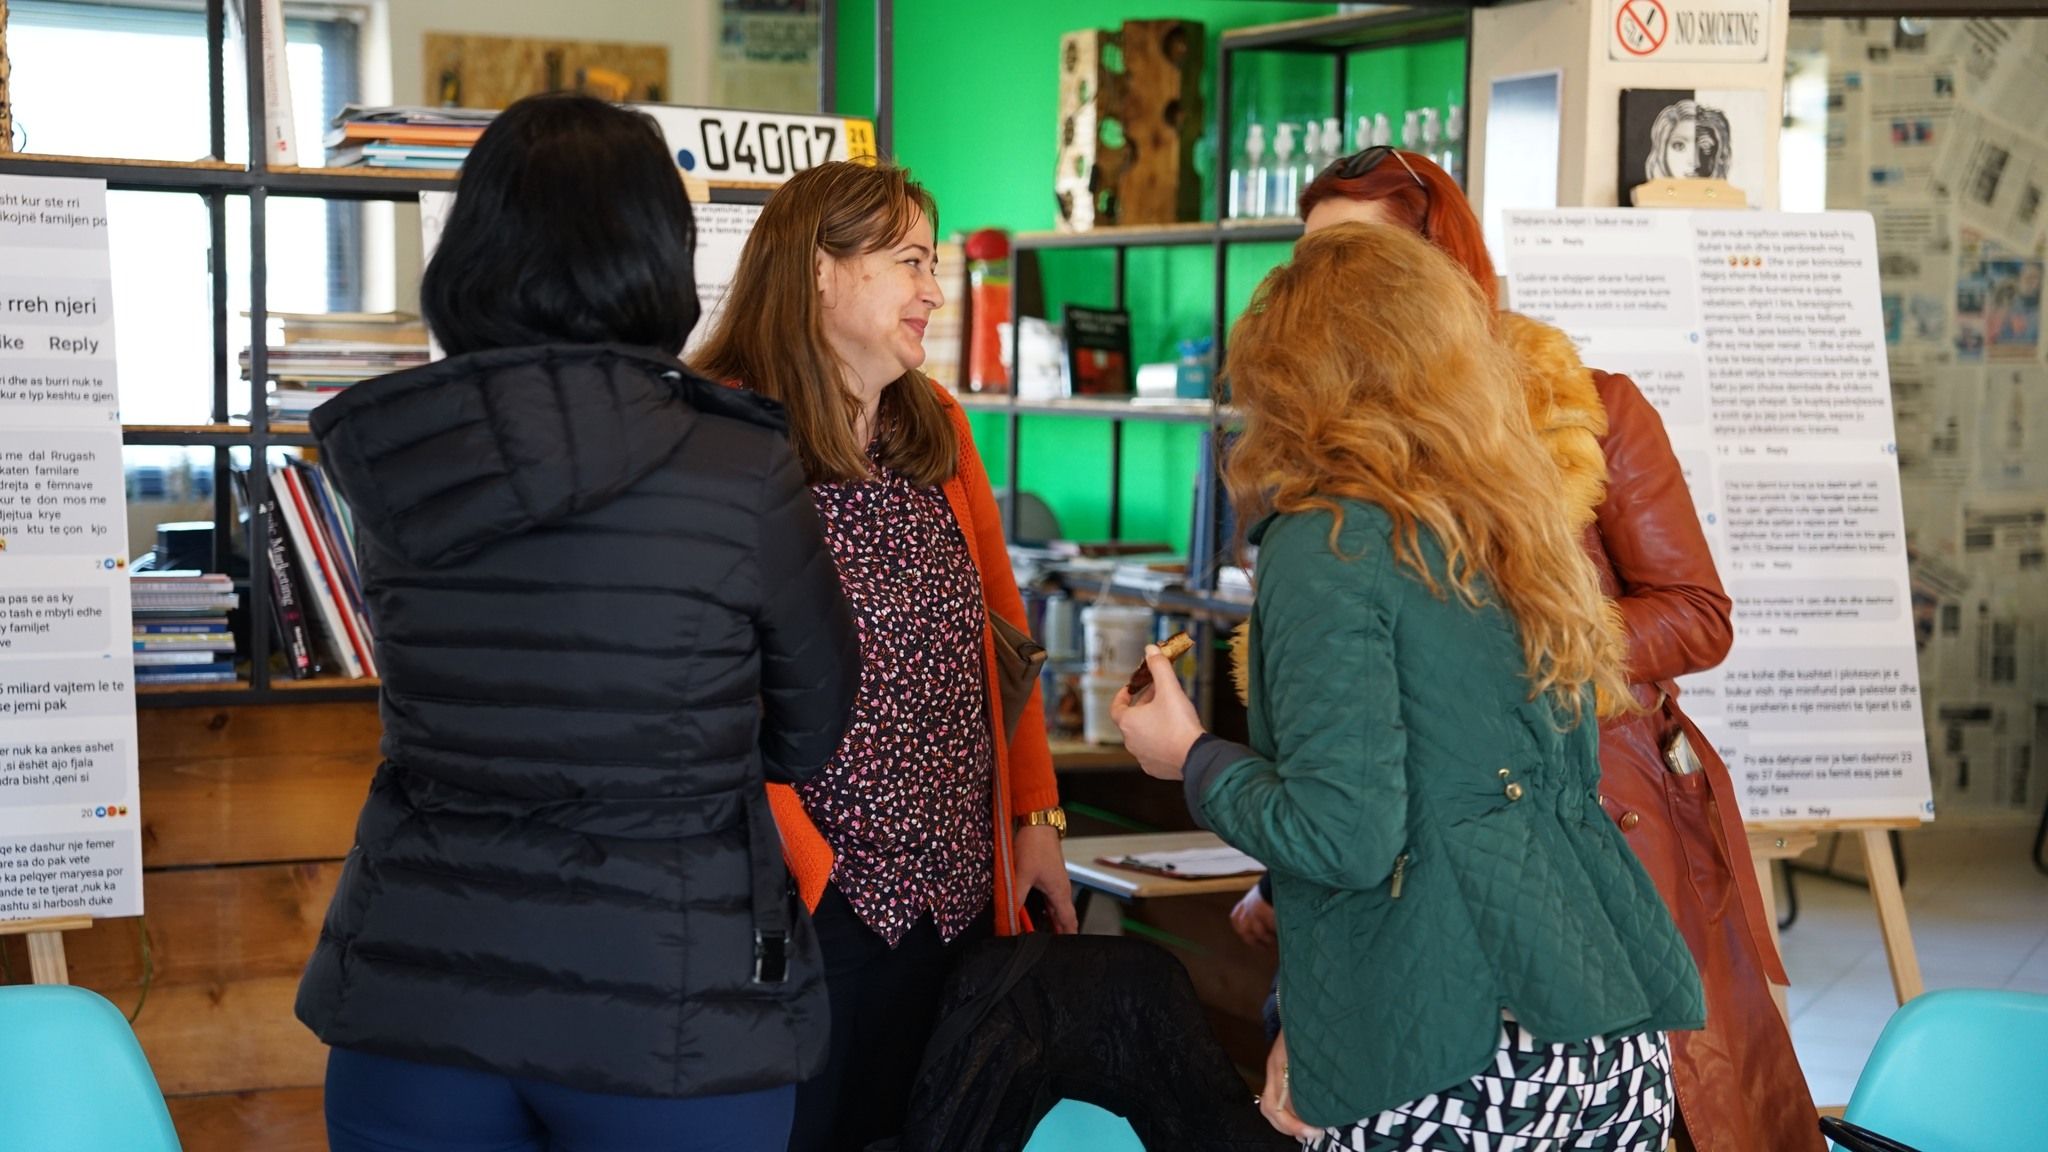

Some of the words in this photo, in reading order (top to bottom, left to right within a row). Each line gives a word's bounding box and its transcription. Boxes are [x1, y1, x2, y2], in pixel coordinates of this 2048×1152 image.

[1675, 12, 1695, 45] NO
[1698, 11, 1758, 46] SMOKING
[700, 118, 836, 174] 04007
[21, 195, 40, 207] kur
[45, 198, 63, 209] ste
[40, 212, 89, 228] familjen
[9, 296, 48, 312] rreh
[55, 296, 96, 317] njeri
[49, 336, 98, 354] Reply
[8, 375, 28, 386] dhe
[31, 378, 43, 386] as
[45, 375, 69, 387] burri
[72, 377, 90, 387] nuk
[93, 377, 103, 387] te
[1, 388, 16, 399] kur
[29, 390, 44, 402] lyp
[47, 390, 80, 401] keshtu
[92, 392, 114, 403] gjen
[6, 453, 23, 461] me
[29, 451, 45, 461] dal
[51, 451, 95, 463] Rrugash
[35, 466, 79, 476] familare
[21, 496, 31, 505] te
[37, 494, 58, 505] don
[63, 496, 86, 505] mos
[90, 496, 107, 505] me
[38, 510, 61, 521] krye
[27, 524, 44, 535] ktu
[50, 525, 59, 535] te
[91, 523, 107, 536] kjo
[9, 595, 28, 605] pas
[31, 595, 44, 603] se
[46, 595, 59, 603] as
[62, 592, 73, 605] ky
[9, 608, 32, 618] tash
[45, 607, 74, 619] mbyti
[77, 607, 102, 617] edhe
[10, 621, 50, 635] familjet
[8, 681, 50, 694] miliard
[54, 680, 95, 695] vajtem
[98, 679, 109, 691] le
[113, 679, 124, 691] te
[14, 699, 40, 714] jemi
[44, 698, 67, 713] pak
[13, 745, 31, 755] nuk
[35, 745, 47, 754] ka
[51, 743, 82, 754] ankes
[85, 742, 114, 752] ashet
[52, 760, 67, 771] ajo
[71, 757, 93, 769] fjala
[23, 774, 49, 785] bisht
[81, 772, 89, 783] si
[81, 808, 93, 818] 20
[15, 843, 27, 853] ke
[30, 841, 65, 853] dashur
[68, 841, 83, 852] nje
[86, 840, 115, 850] femer
[17, 860, 28, 868] sa
[32, 857, 45, 867] do
[48, 855, 66, 868] pak
[69, 855, 90, 864] vete
[5, 873, 16, 882] ka
[20, 870, 57, 883] pelqyer
[60, 869, 103, 880] maryesa
[107, 868, 123, 878] por
[27, 887, 36, 896] te
[40, 886, 49, 895] te
[52, 883, 78, 896] tjerat
[104, 881, 116, 891] ka
[32, 898, 41, 909] si
[44, 896, 86, 909] harbosh
[89, 896, 113, 906] duke
